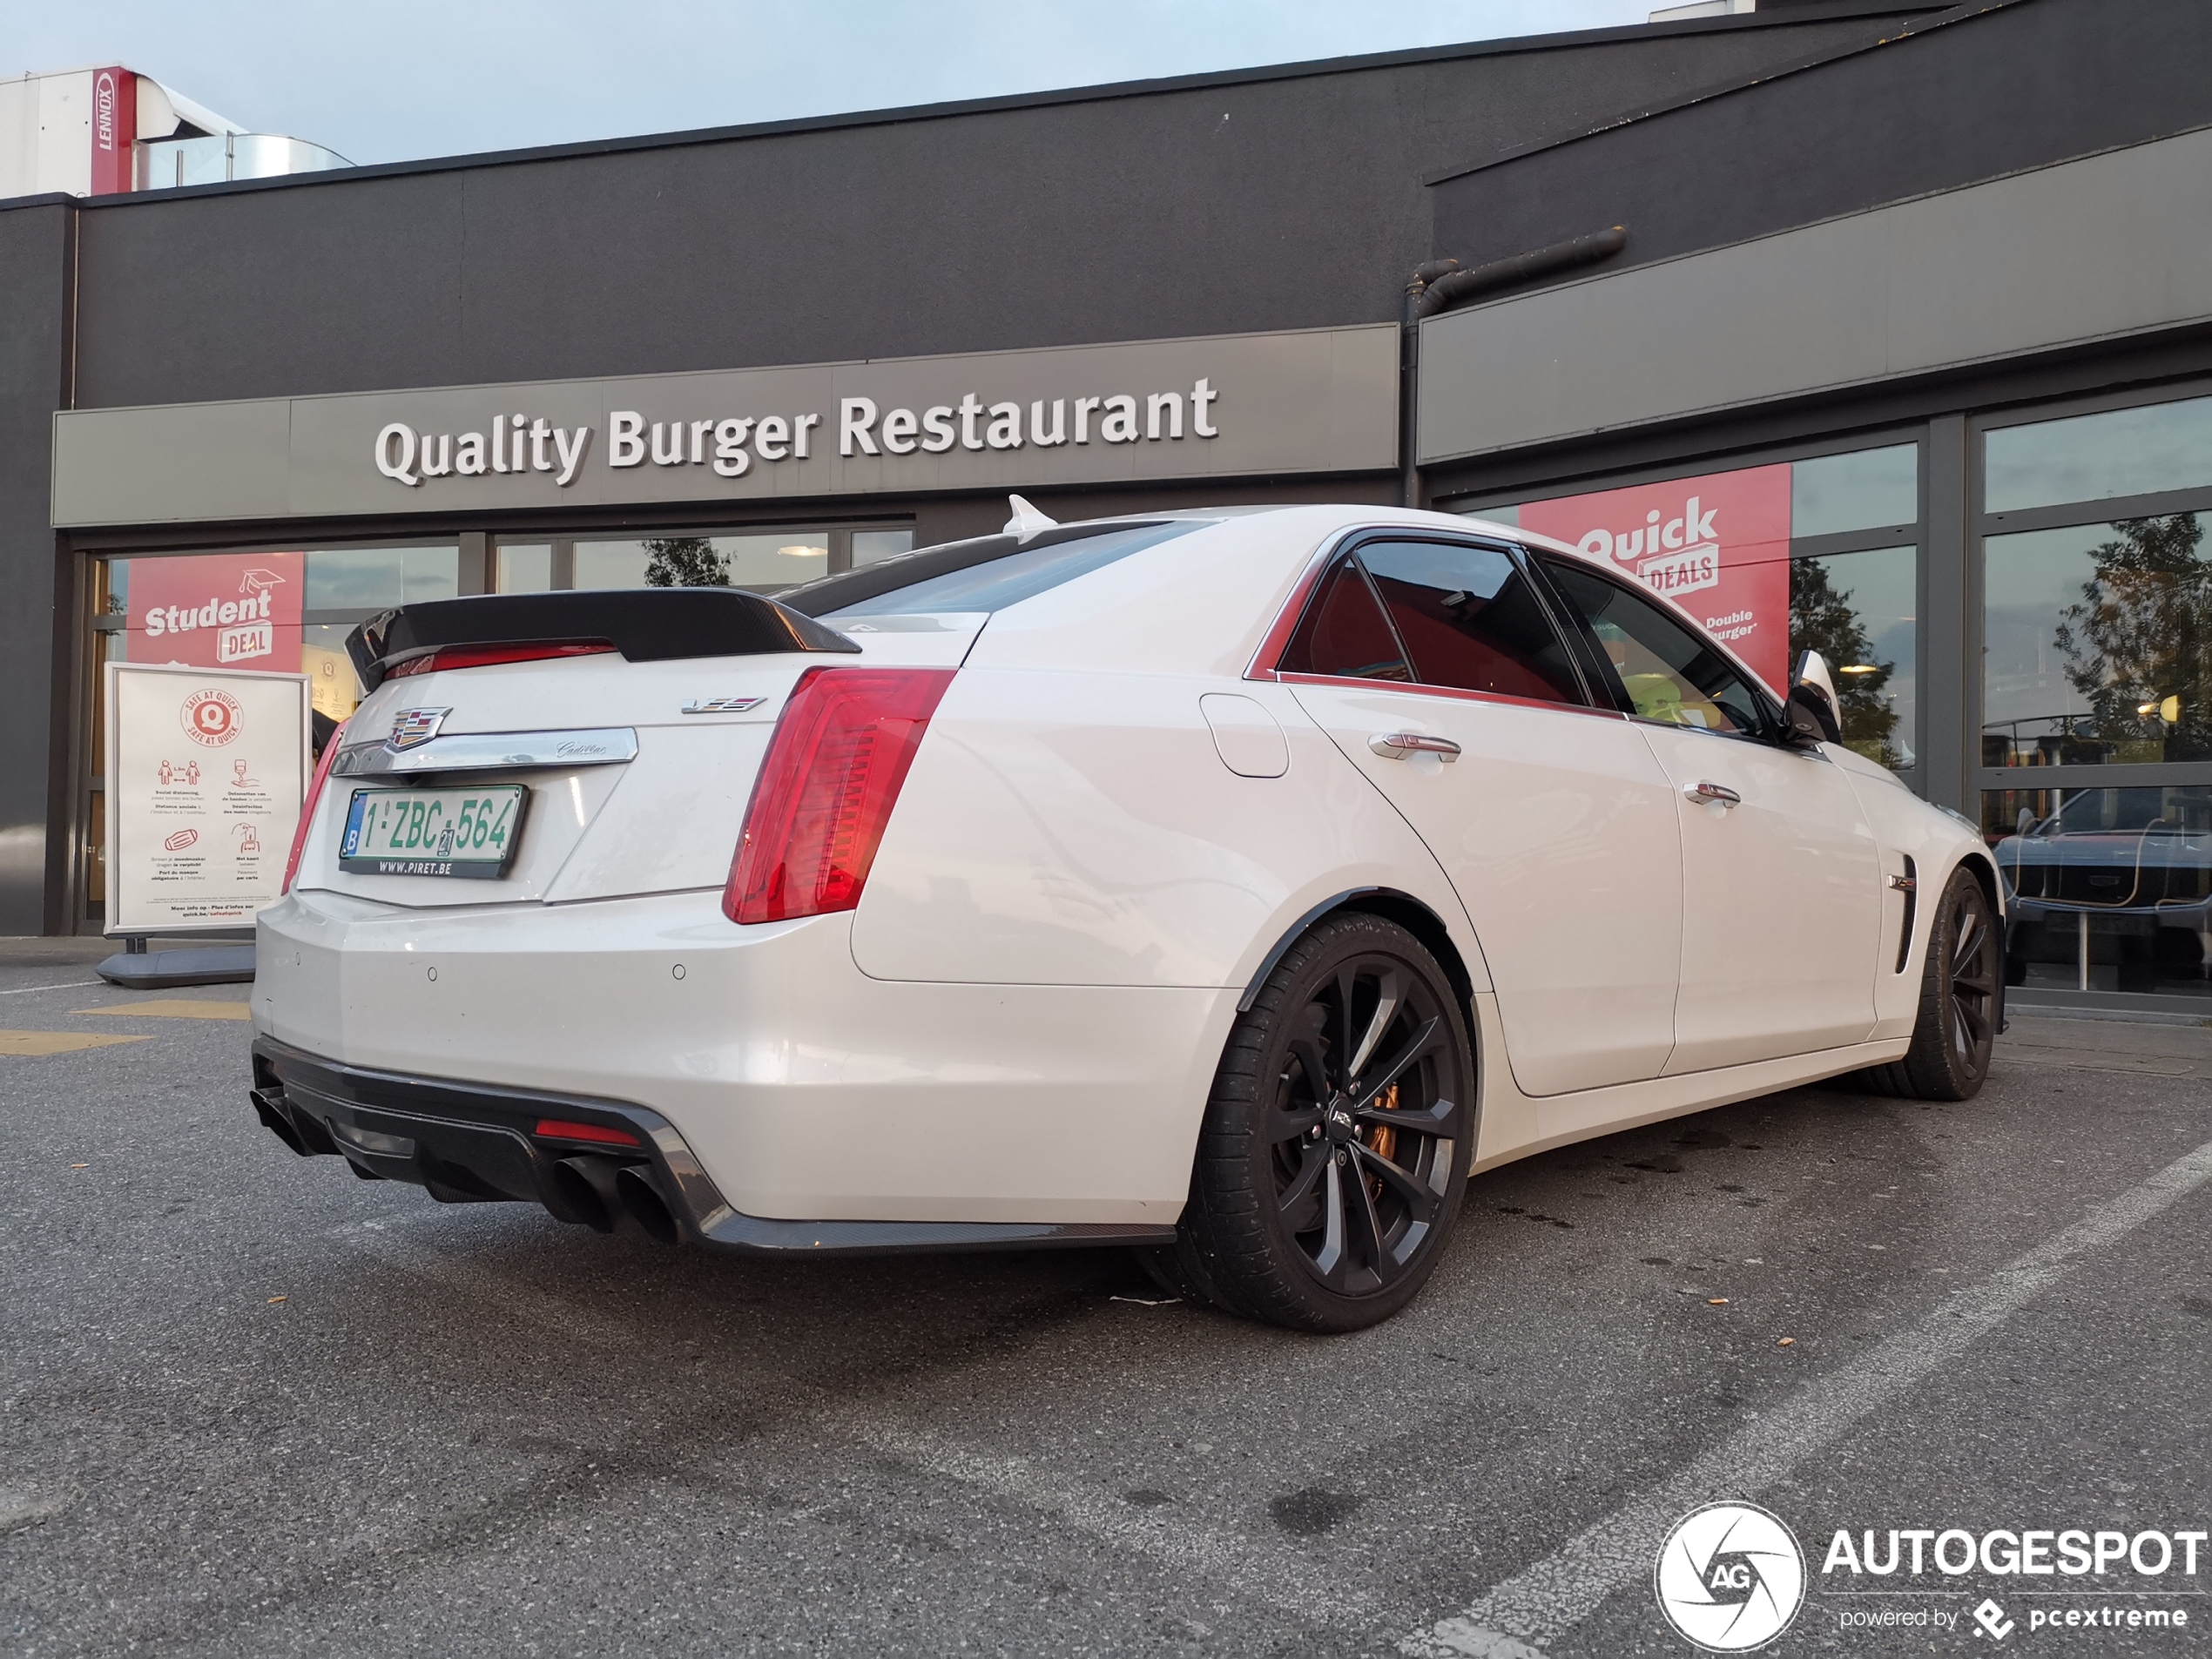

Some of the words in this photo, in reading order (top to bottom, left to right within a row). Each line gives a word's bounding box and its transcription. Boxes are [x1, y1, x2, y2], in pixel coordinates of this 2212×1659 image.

[98, 88, 112, 151] LENNOX
[375, 414, 596, 486] Quality
[609, 411, 823, 477] Burger
[840, 377, 1219, 457] Restaurant
[1577, 496, 1718, 560] Quick
[1650, 556, 1713, 590] DEALS
[145, 590, 271, 636] Student
[1707, 610, 1753, 629] Double
[229, 631, 266, 655] DEAL
[185, 694, 202, 711] SAFE
[205, 691, 213, 699] AT
[216, 691, 239, 711] QUICK
[187, 726, 205, 743] SAFE
[206, 737, 215, 745] AT
[217, 725, 239, 745] QUICK
[556, 741, 607, 758] Cadillac
[366, 799, 513, 848] 1-ZBC-564
[347, 829, 358, 851] B
[380, 860, 452, 874] WWW.PIRET.BE
